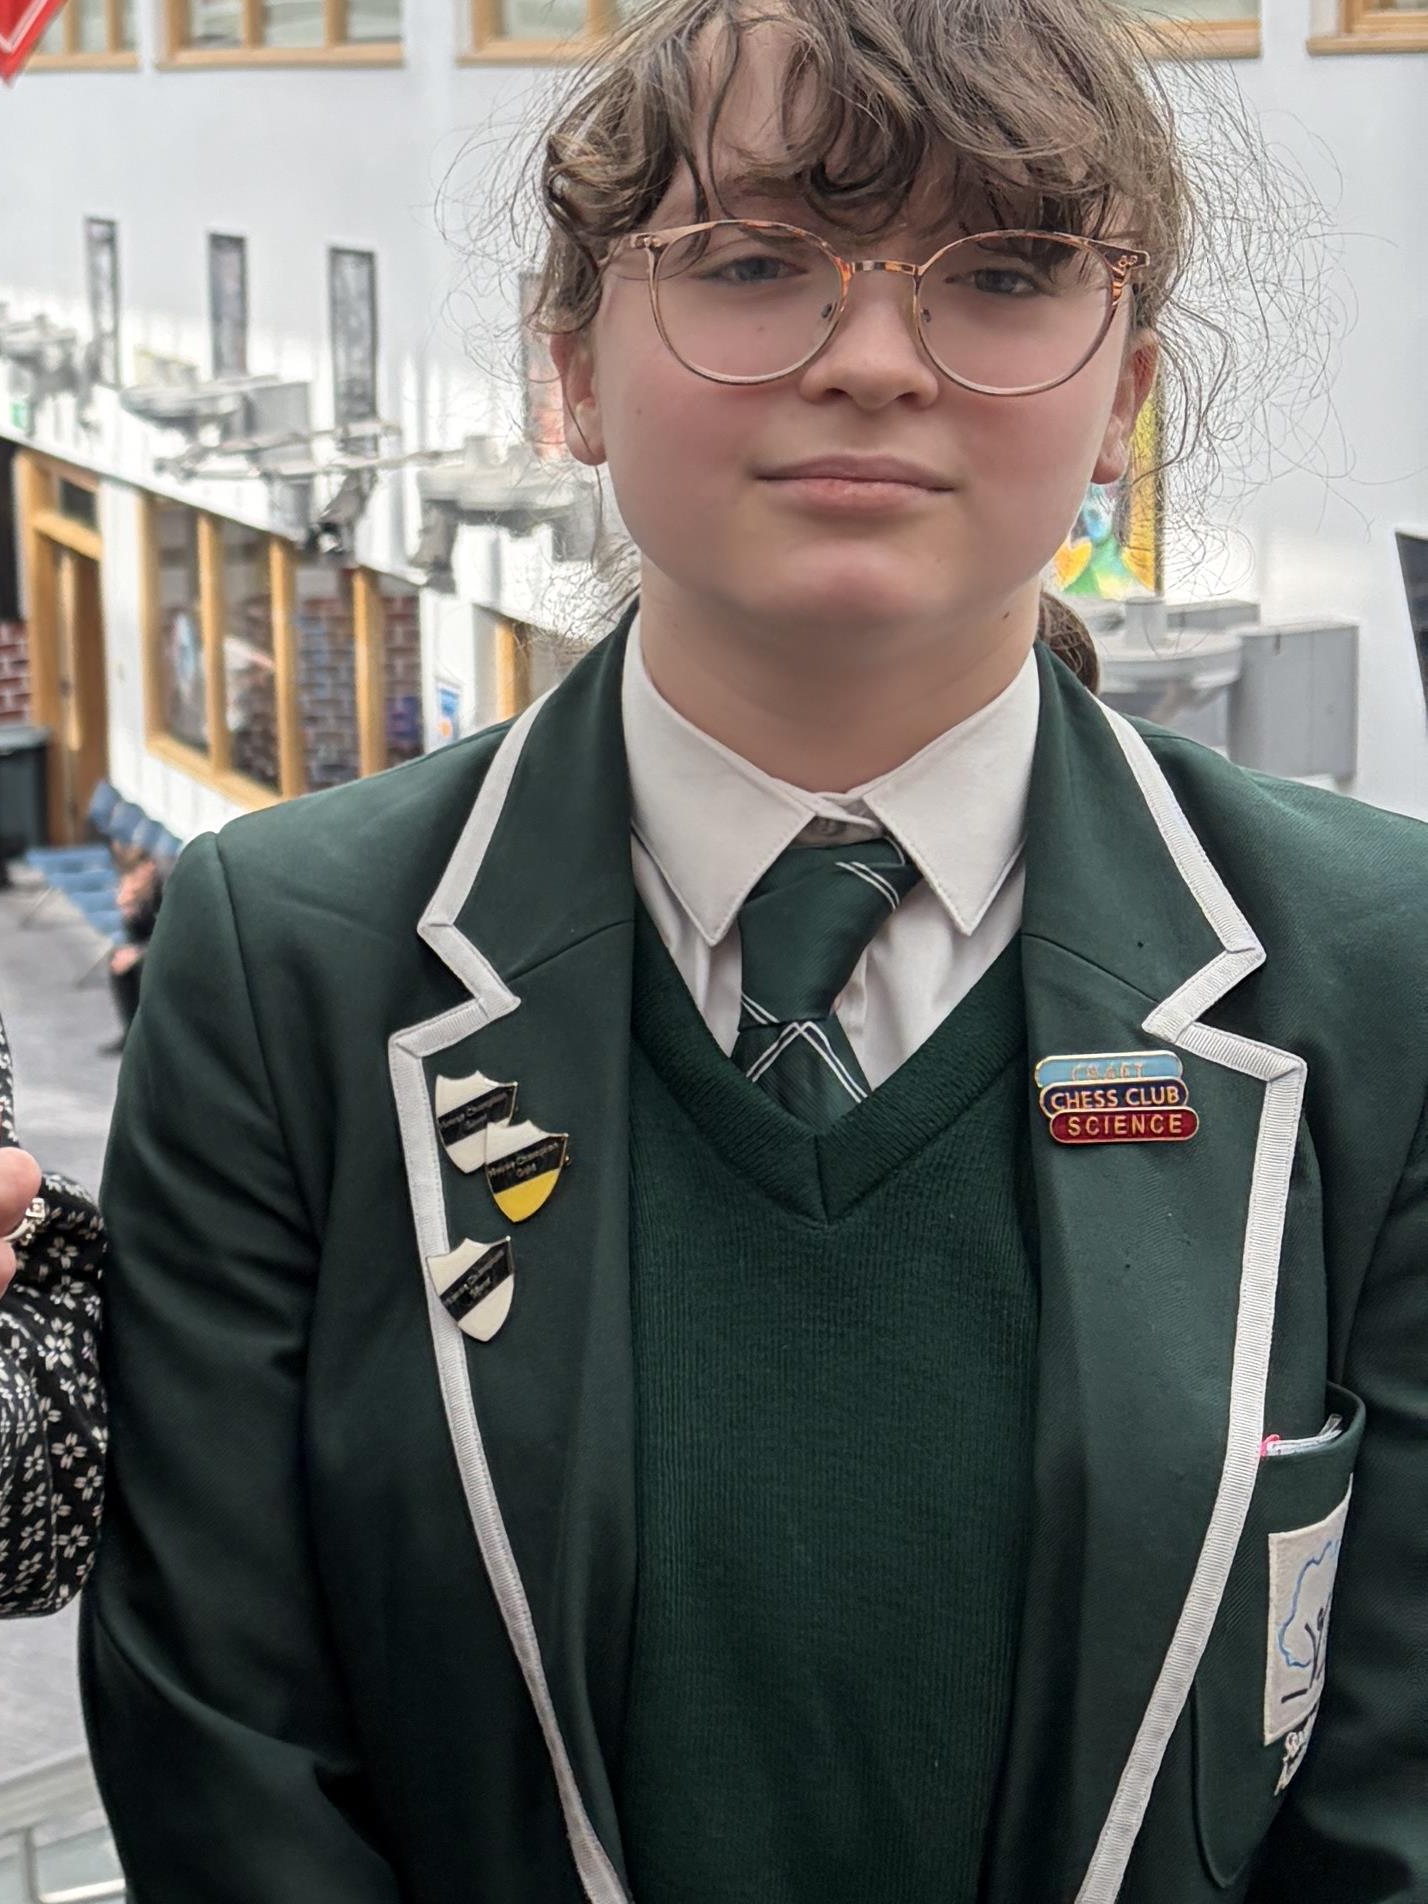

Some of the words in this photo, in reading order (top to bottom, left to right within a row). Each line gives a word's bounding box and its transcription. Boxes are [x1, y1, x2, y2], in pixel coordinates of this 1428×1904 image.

[1051, 1089, 1118, 1110] CHESS
[1125, 1086, 1180, 1106] CLUB
[1068, 1114, 1183, 1136] SCIENCE
